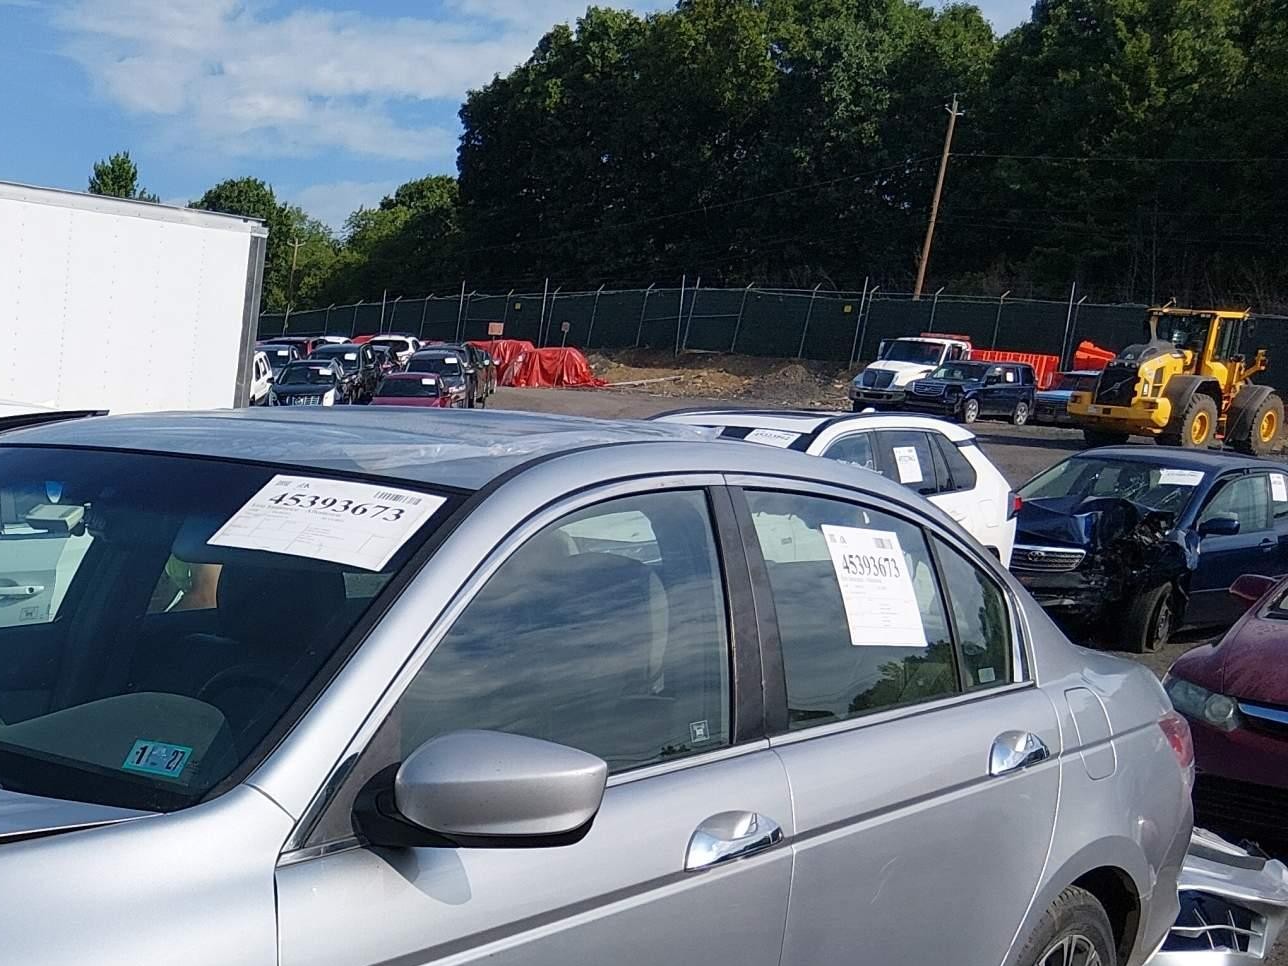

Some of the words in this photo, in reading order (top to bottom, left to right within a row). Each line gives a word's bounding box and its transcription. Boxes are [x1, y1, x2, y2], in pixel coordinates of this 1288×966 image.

[268, 491, 405, 523] 45393673
[842, 554, 901, 578] 45393673
[165, 749, 185, 771] 27
